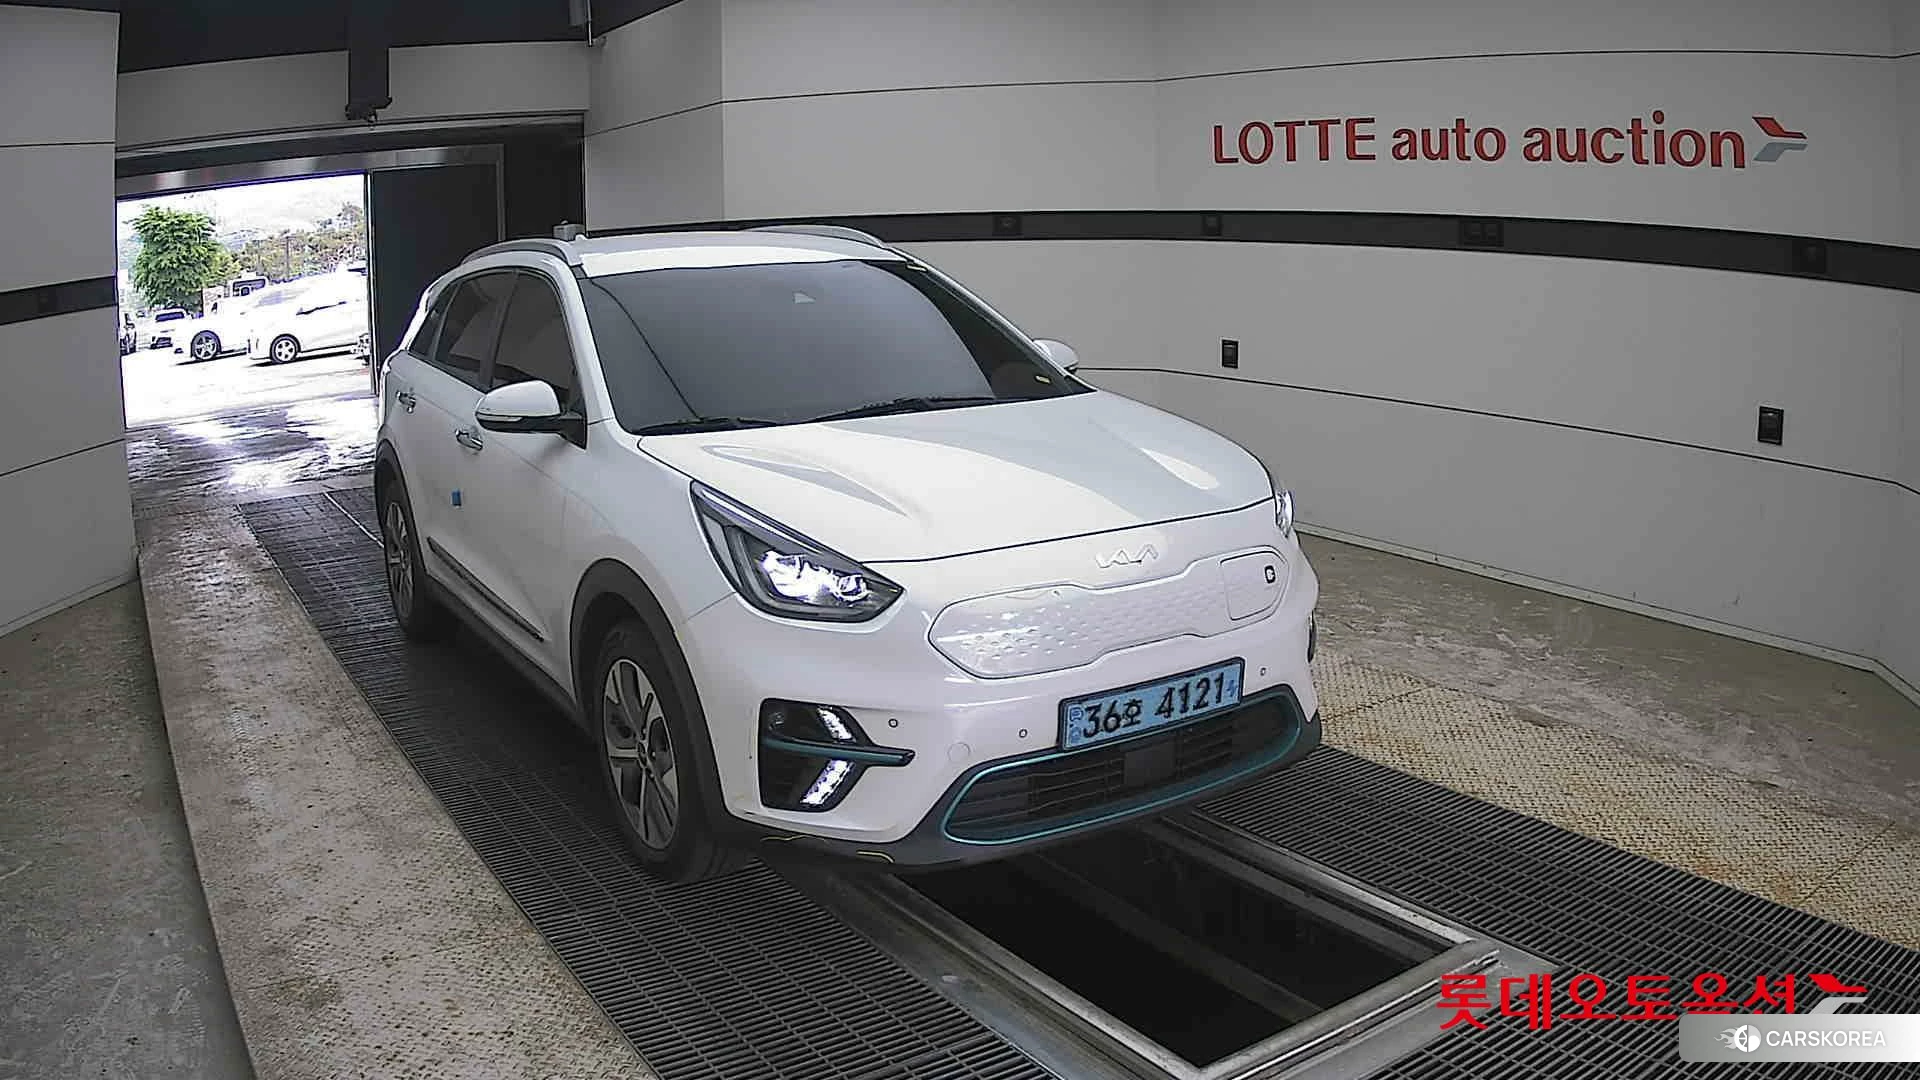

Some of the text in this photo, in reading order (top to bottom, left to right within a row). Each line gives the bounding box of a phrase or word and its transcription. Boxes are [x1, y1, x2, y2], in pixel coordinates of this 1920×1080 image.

[1212, 111, 1746, 168] LOTTE auto auction
[1083, 697, 1143, 738] 36호
[1154, 671, 1225, 719] 4121
